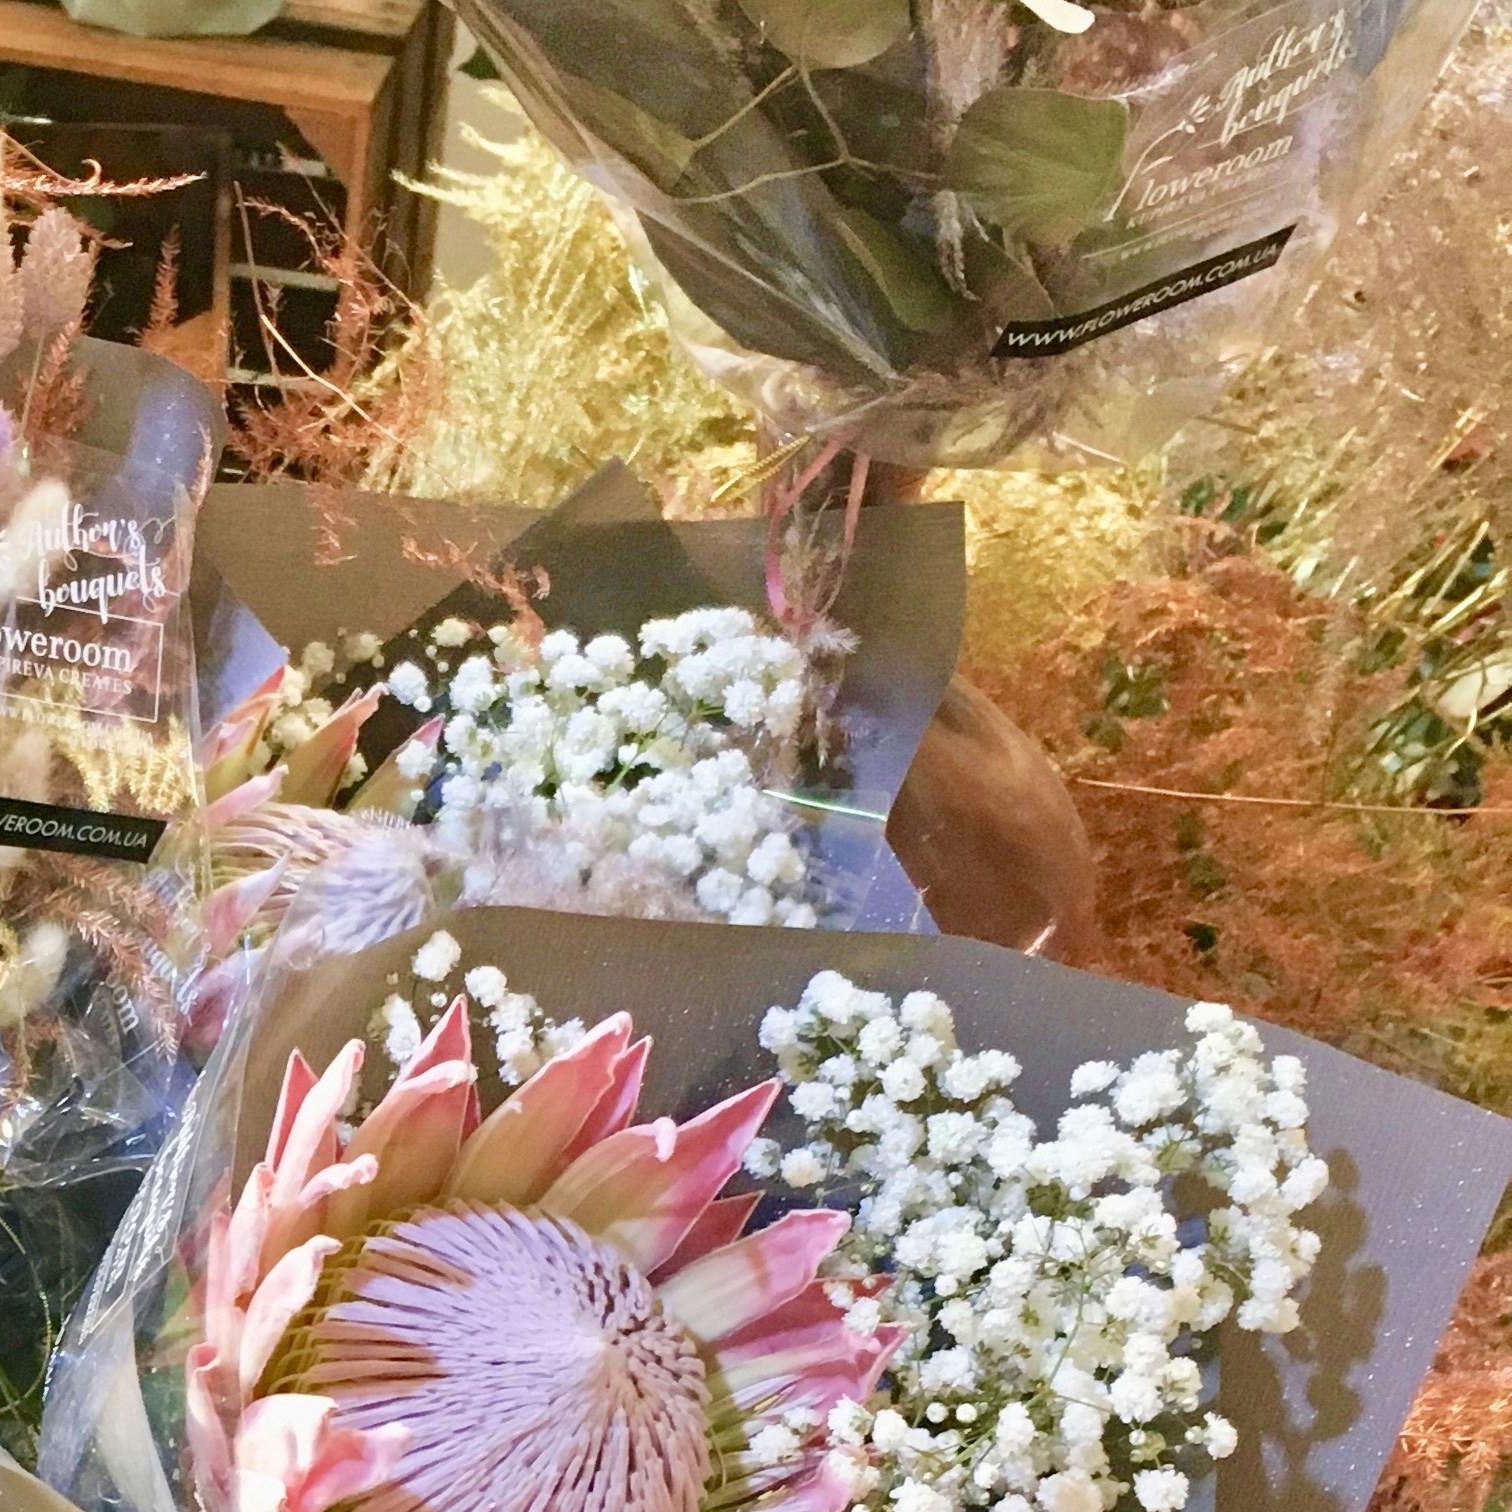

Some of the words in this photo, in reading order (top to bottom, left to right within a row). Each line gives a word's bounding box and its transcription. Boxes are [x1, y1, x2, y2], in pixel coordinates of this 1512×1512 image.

[1007, 243, 1278, 347] WWW.FLOWEROOM.COM.UA
[38, 545, 170, 624] bouquets
[59, 667, 132, 696] CREATES
